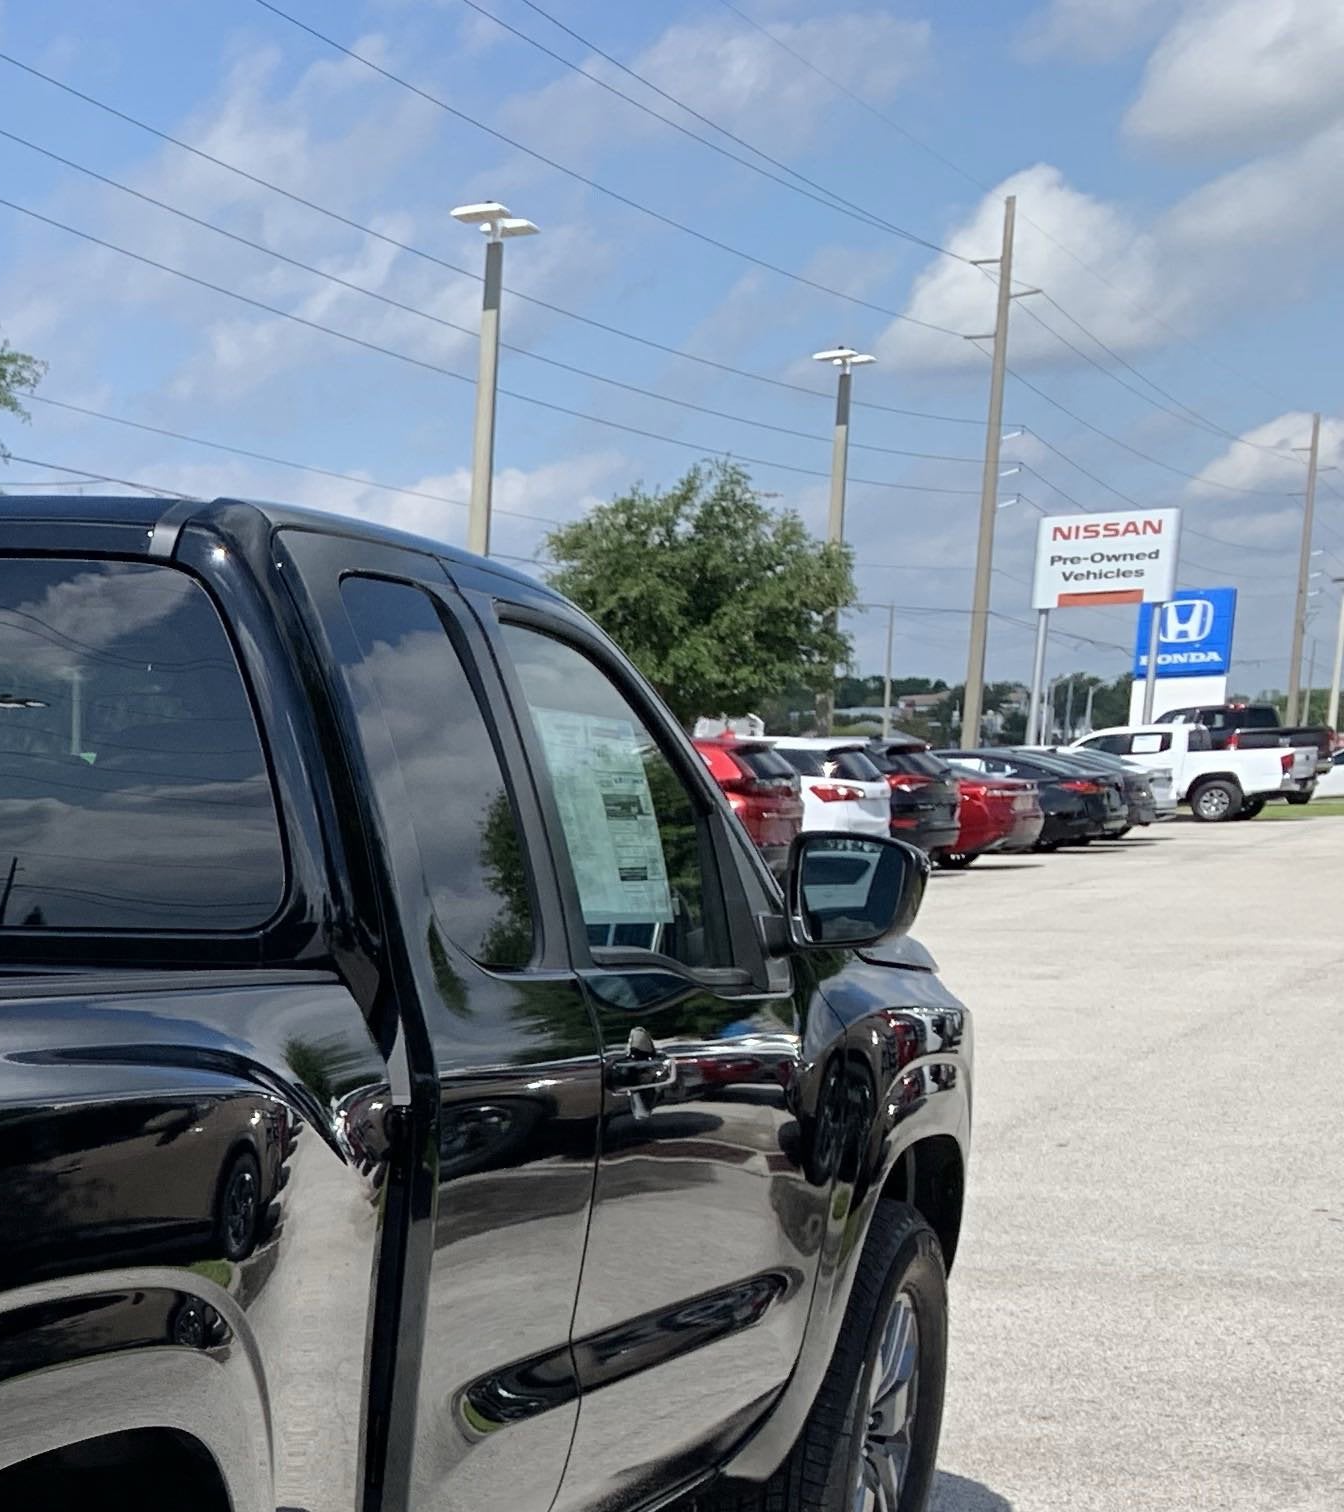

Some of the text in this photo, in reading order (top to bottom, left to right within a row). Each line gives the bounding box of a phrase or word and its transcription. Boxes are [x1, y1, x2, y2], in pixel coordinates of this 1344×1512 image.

[1052, 519, 1163, 541] NISSAN
[1050, 549, 1160, 566] Pre-Owned
[1061, 568, 1145, 582] Vehicles
